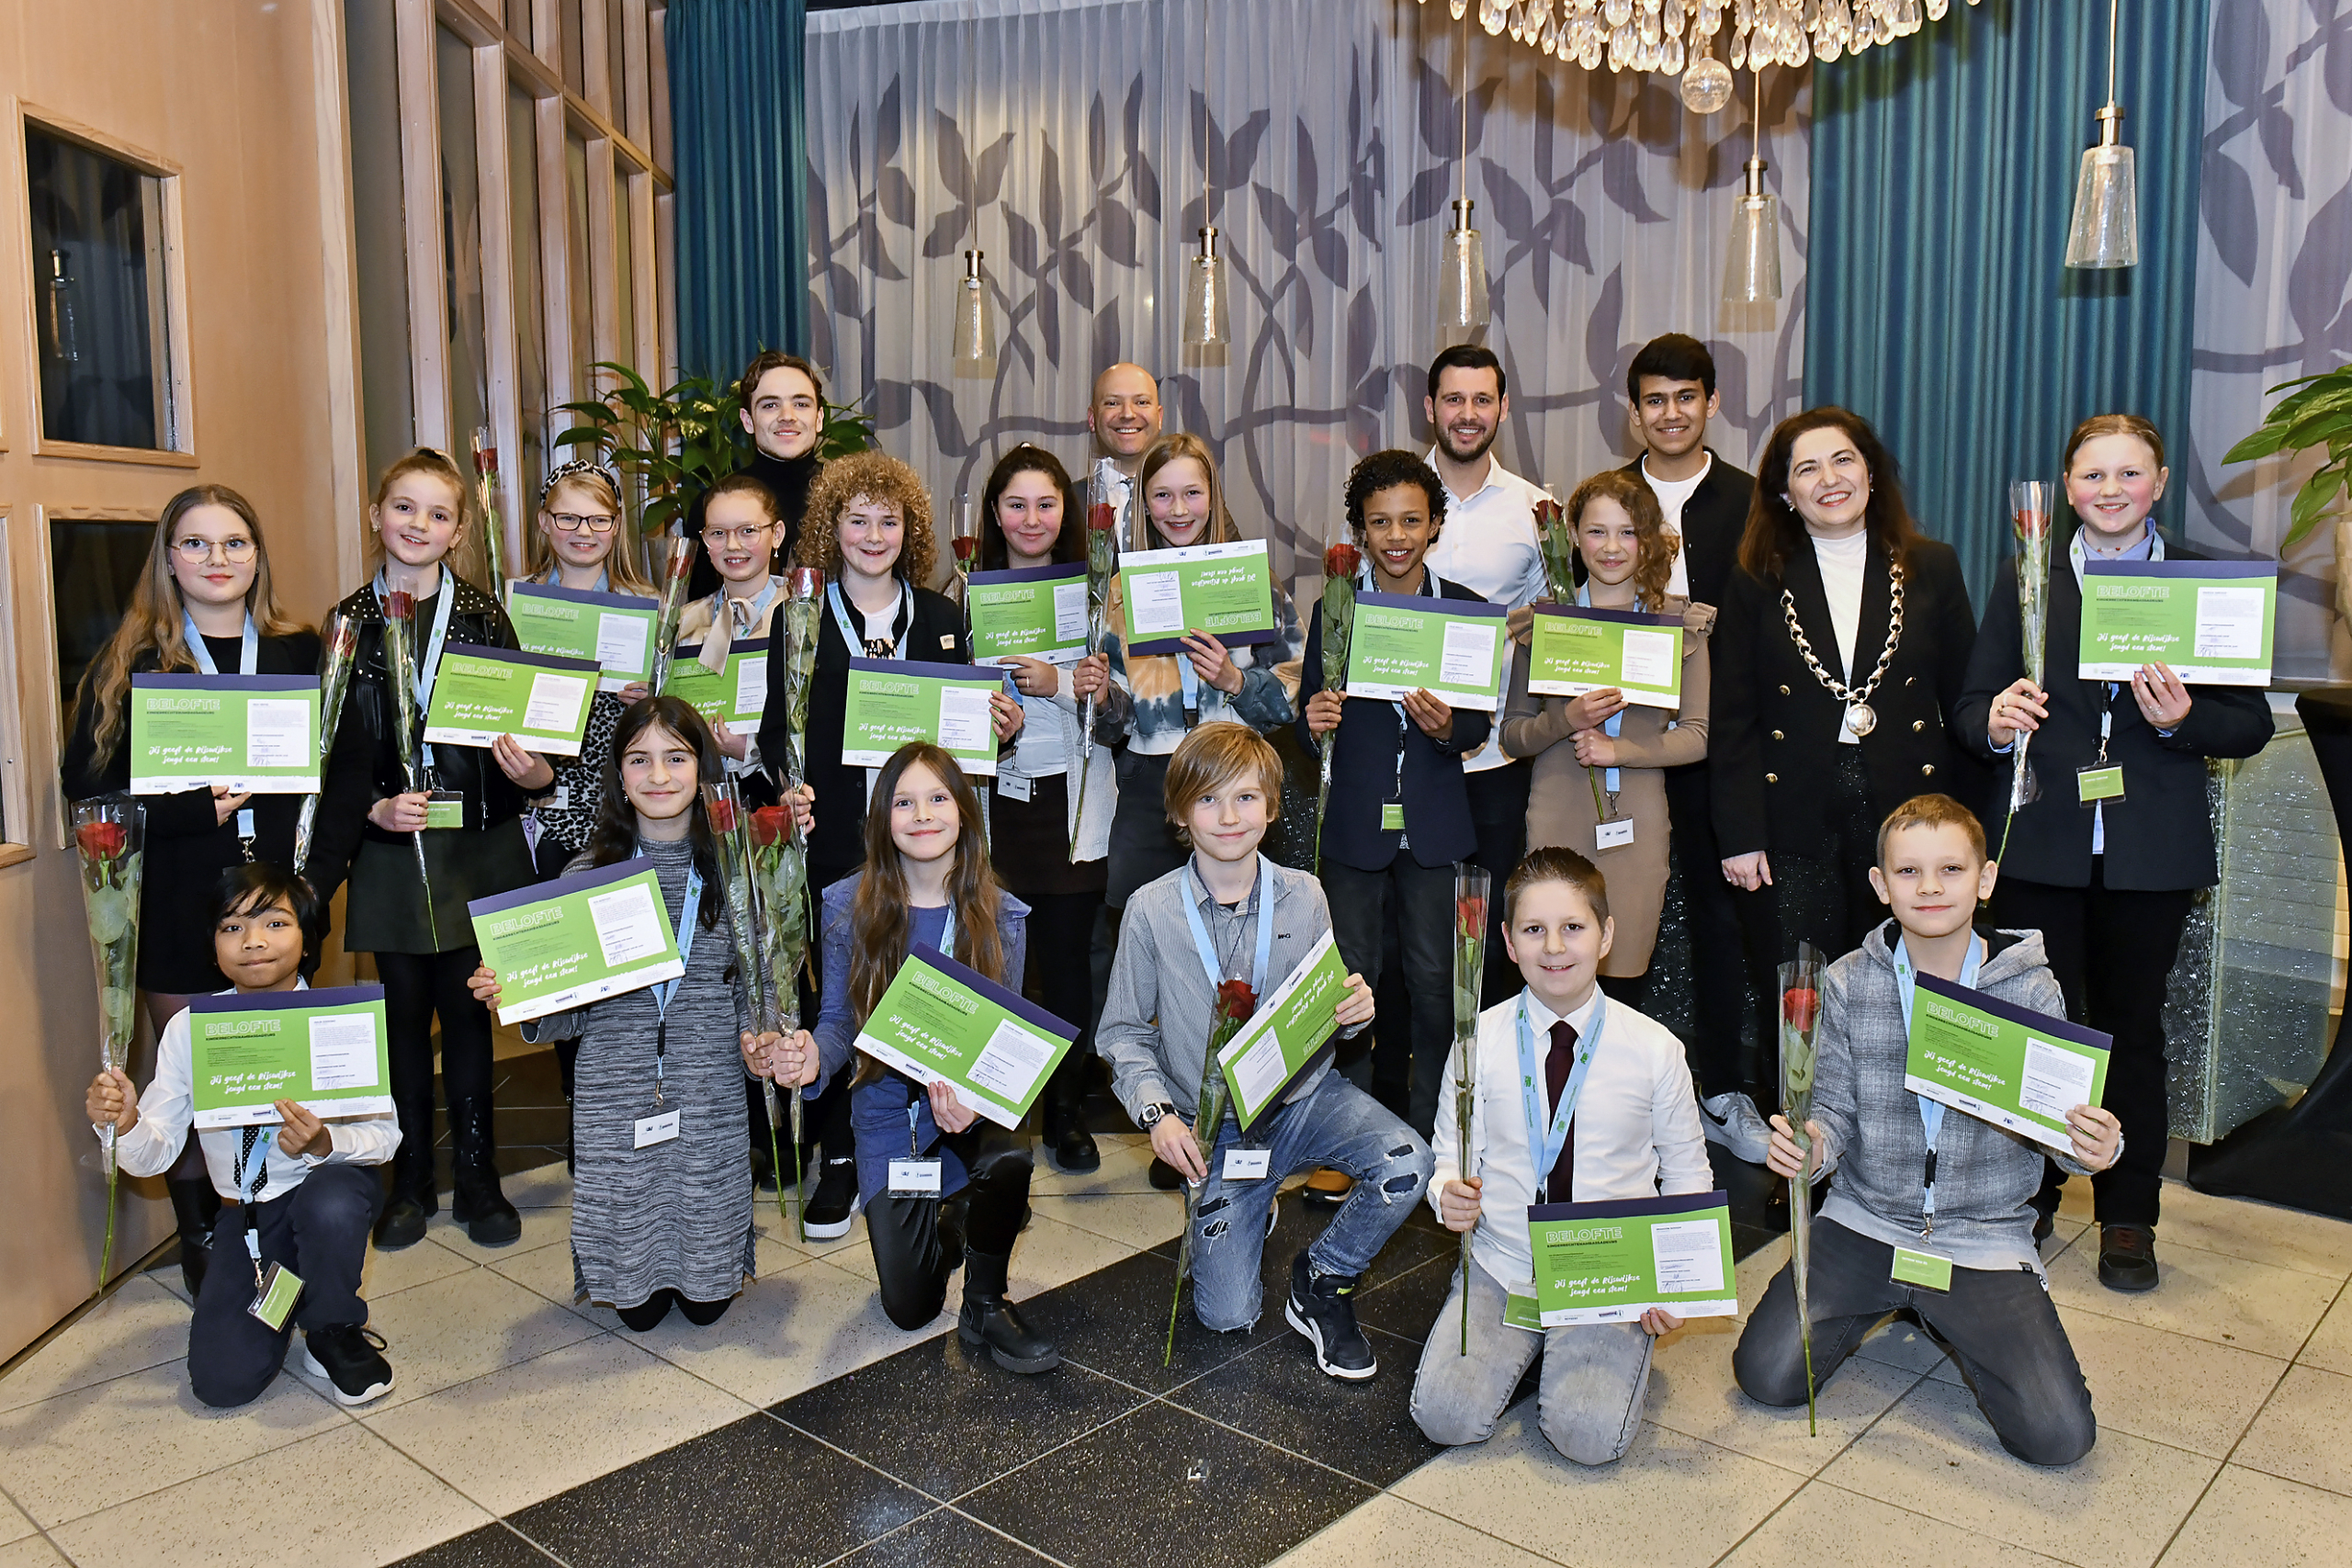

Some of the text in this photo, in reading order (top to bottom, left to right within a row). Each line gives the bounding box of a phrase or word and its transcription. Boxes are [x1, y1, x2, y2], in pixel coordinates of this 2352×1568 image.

[979, 589, 1035, 603] BELOFTE
[2097, 585, 2170, 597] BELOFTE
[522, 604, 579, 619] BELOFTE
[1205, 612, 1261, 626] BELOFTE
[1365, 614, 1424, 628] BELOFTE
[1544, 622, 1602, 636] BELOFTE
[2097, 633, 2109, 642] Jij
[2110, 633, 2130, 642] geeft
[2143, 634, 2180, 644] Rijswijkse
[2109, 643, 2130, 652] jeugd
[2147, 643, 2166, 652] stem!
[1374, 657, 1389, 665] geeft
[452, 662, 513, 679] BELOFTE
[1373, 666, 1389, 674] jeugd
[859, 680, 919, 694] BELOFTE
[147, 698, 220, 710] BELOFTE
[870, 723, 886, 732] geeft
[149, 746, 160, 755] Jij
[163, 746, 182, 755] geeft
[162, 756, 182, 764] jeugd
[200, 755, 219, 763] stem!
[490, 907, 563, 936] BELOFTE
[506, 971, 517, 982] Jij
[520, 966, 538, 979] geeft
[552, 953, 588, 968] Rijswijkse
[523, 965, 578, 987] jeugd een stem!
[911, 971, 979, 1014] BELOFTE
[1927, 1001, 1999, 1037] BELOFTE
[205, 1020, 281, 1036] BELOFTE
[888, 1014, 963, 1057] Jij geeft de Rijswijkse
[895, 1029, 947, 1061] jeugd een stem!
[1924, 1050, 2006, 1086] Jij geeft de Rijswijkse
[210, 1075, 221, 1085] Jij
[224, 1072, 243, 1084] geeft
[258, 1070, 296, 1082] Rijswijkse
[1936, 1065, 1991, 1090] jeugd een stem!
[225, 1084, 245, 1094] jeugd
[264, 1082, 283, 1090] stem!
[1546, 1226, 1623, 1243] BELOFTE
[1555, 1279, 1566, 1289] Jij
[1568, 1278, 1589, 1288] geeft
[1602, 1274, 1641, 1285] Rijswijkse
[1570, 1287, 1590, 1297] jeugd
[1608, 1285, 1628, 1293] stem!
